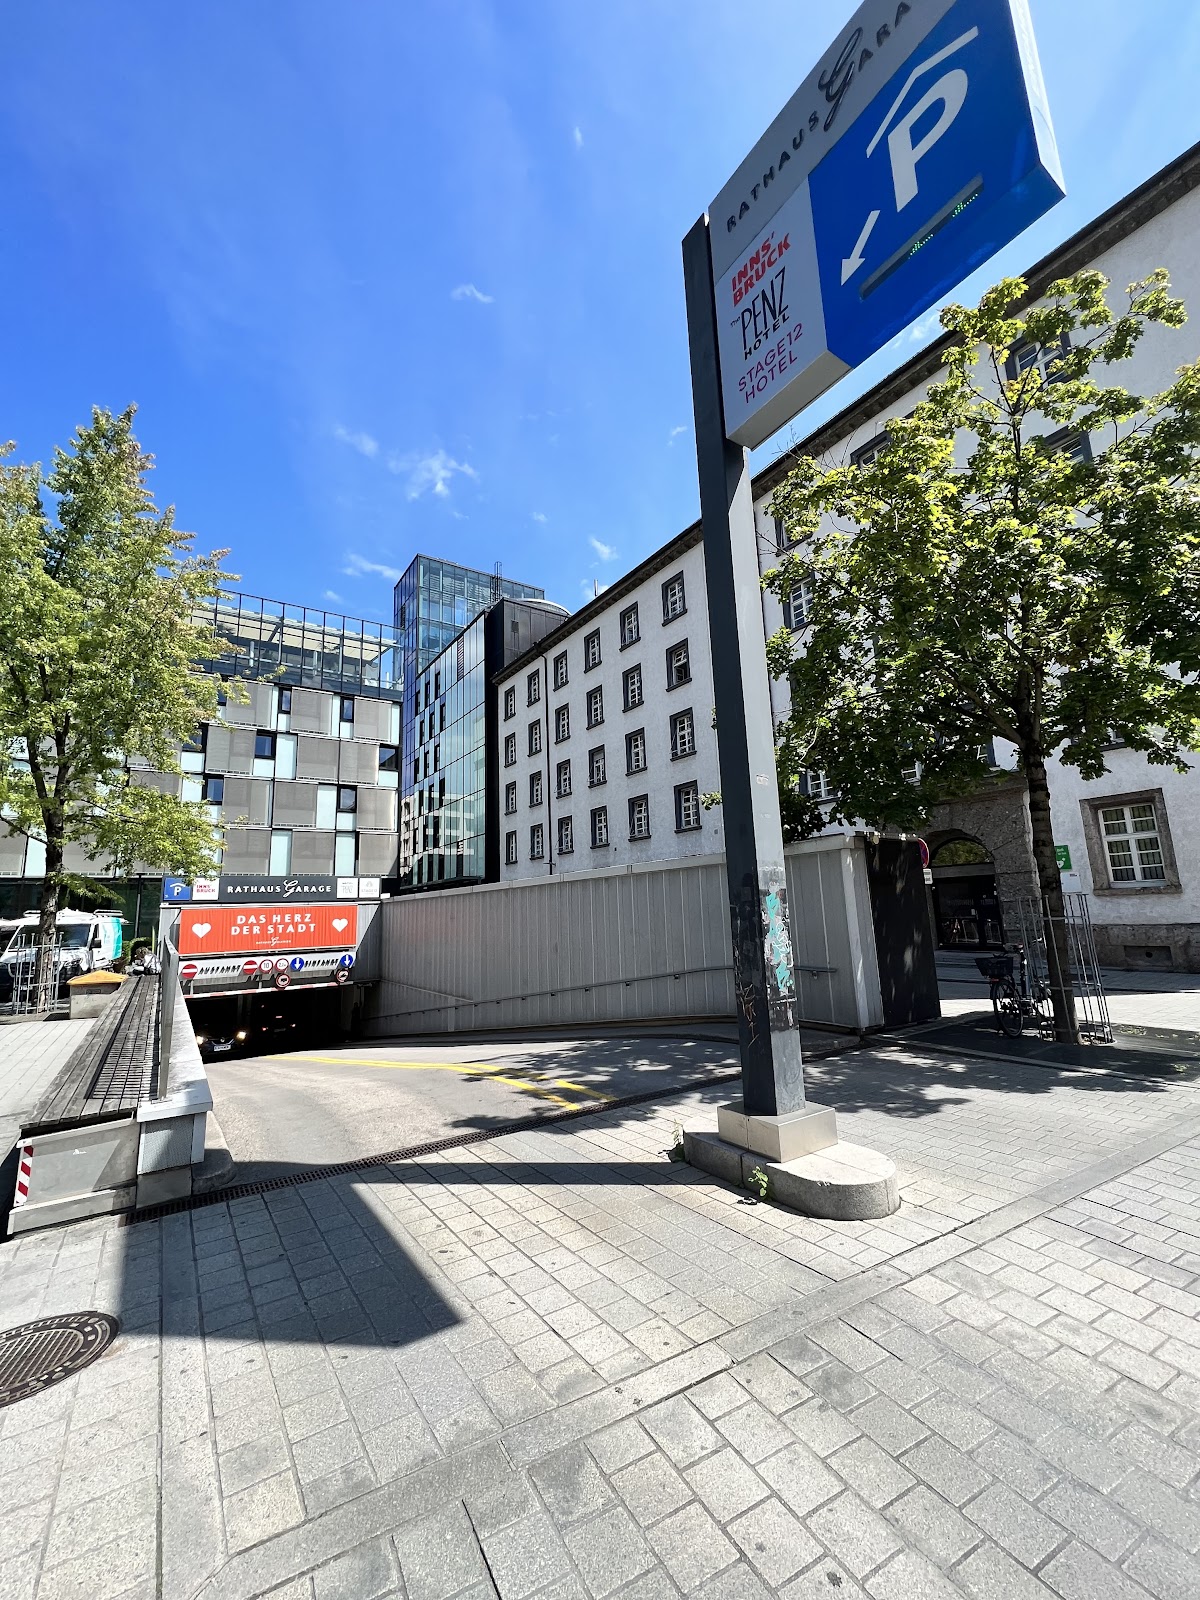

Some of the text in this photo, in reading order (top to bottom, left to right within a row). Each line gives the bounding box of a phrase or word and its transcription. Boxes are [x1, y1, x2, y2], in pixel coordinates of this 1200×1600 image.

[888, 68, 968, 212] P
[734, 233, 791, 307] BRUCK
[741, 266, 788, 350] PENZ
[744, 313, 790, 360] HOTEL
[746, 350, 798, 404] HOTEL
[173, 886, 182, 896] P
[227, 885, 281, 893] RATHAUS
[236, 913, 312, 925] DAS HERZ
[230, 923, 316, 936] DER STADT
[198, 964, 242, 975] AUSFAHRT
[304, 958, 339, 968] EINFAHRT
